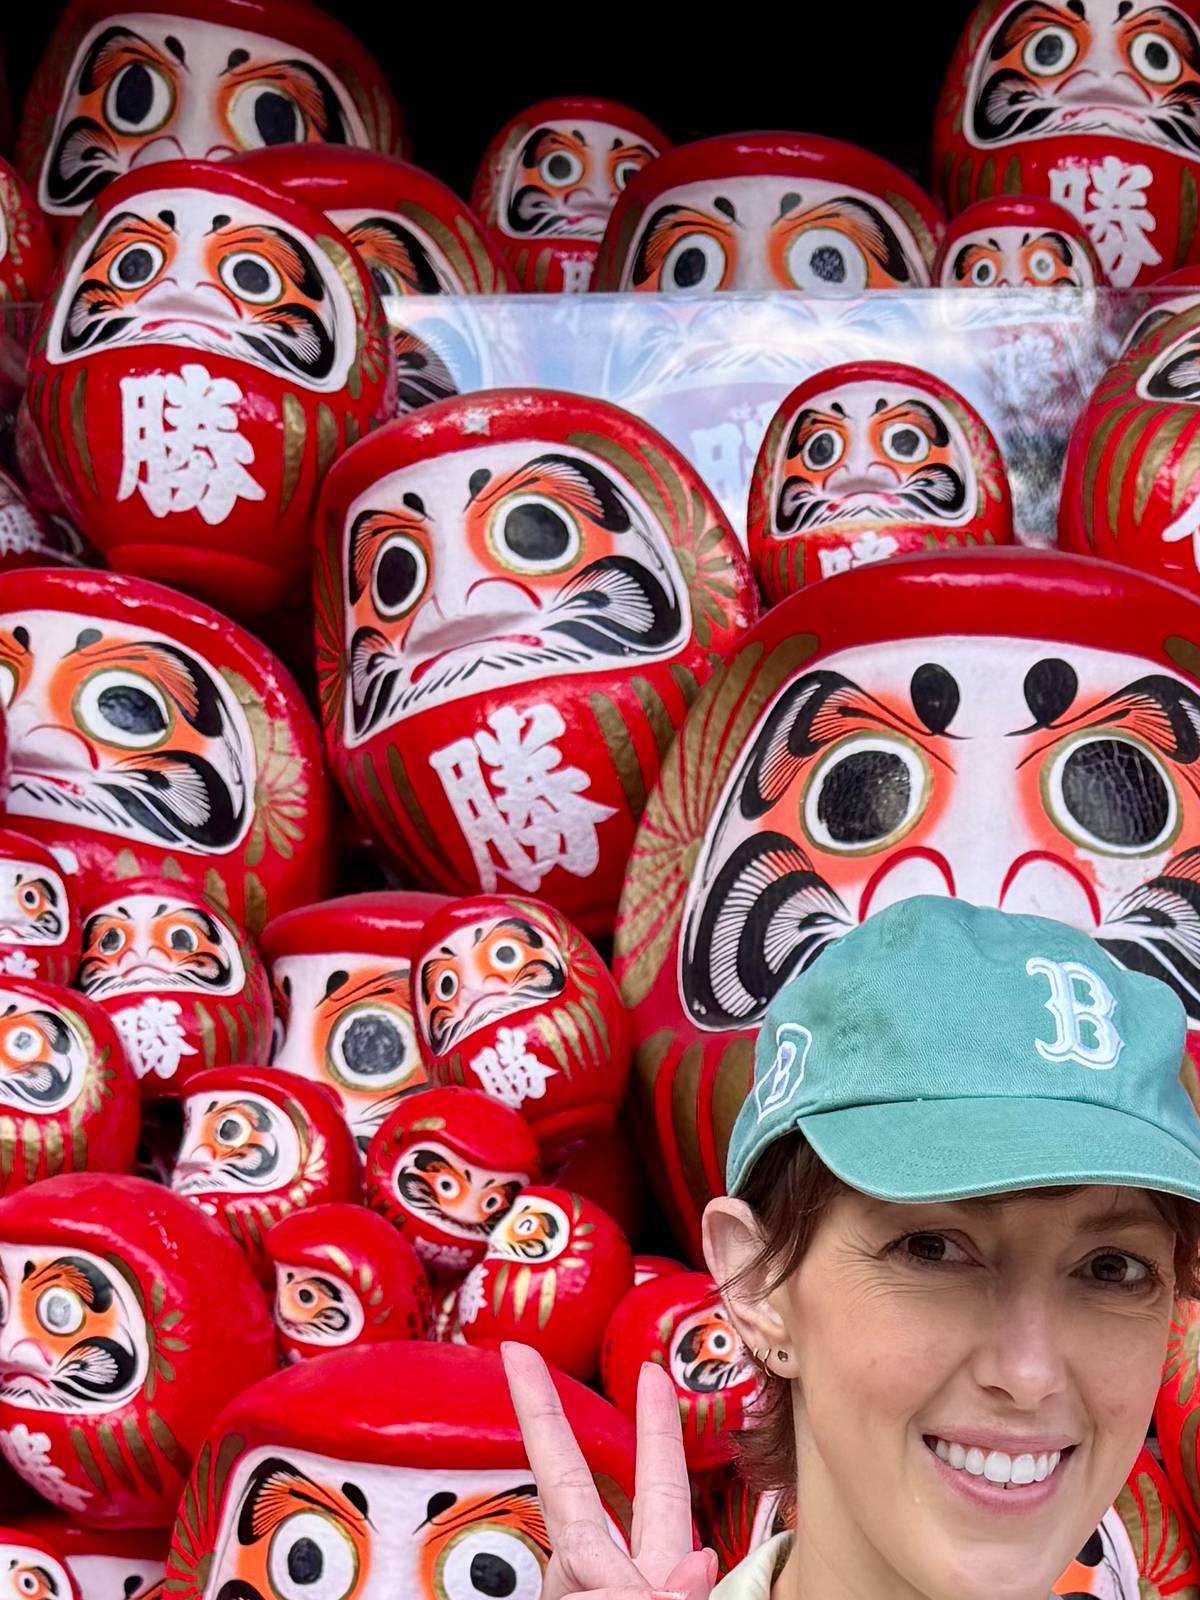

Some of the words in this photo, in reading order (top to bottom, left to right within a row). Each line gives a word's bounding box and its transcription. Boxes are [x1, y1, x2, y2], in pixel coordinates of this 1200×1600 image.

[1048, 156, 1162, 289] 勝
[118, 364, 267, 525] 勝
[429, 704, 620, 893] 勝
[109, 998, 198, 1080] 勝
[470, 1027, 560, 1109] 勝
[1026, 957, 1126, 1070] B
